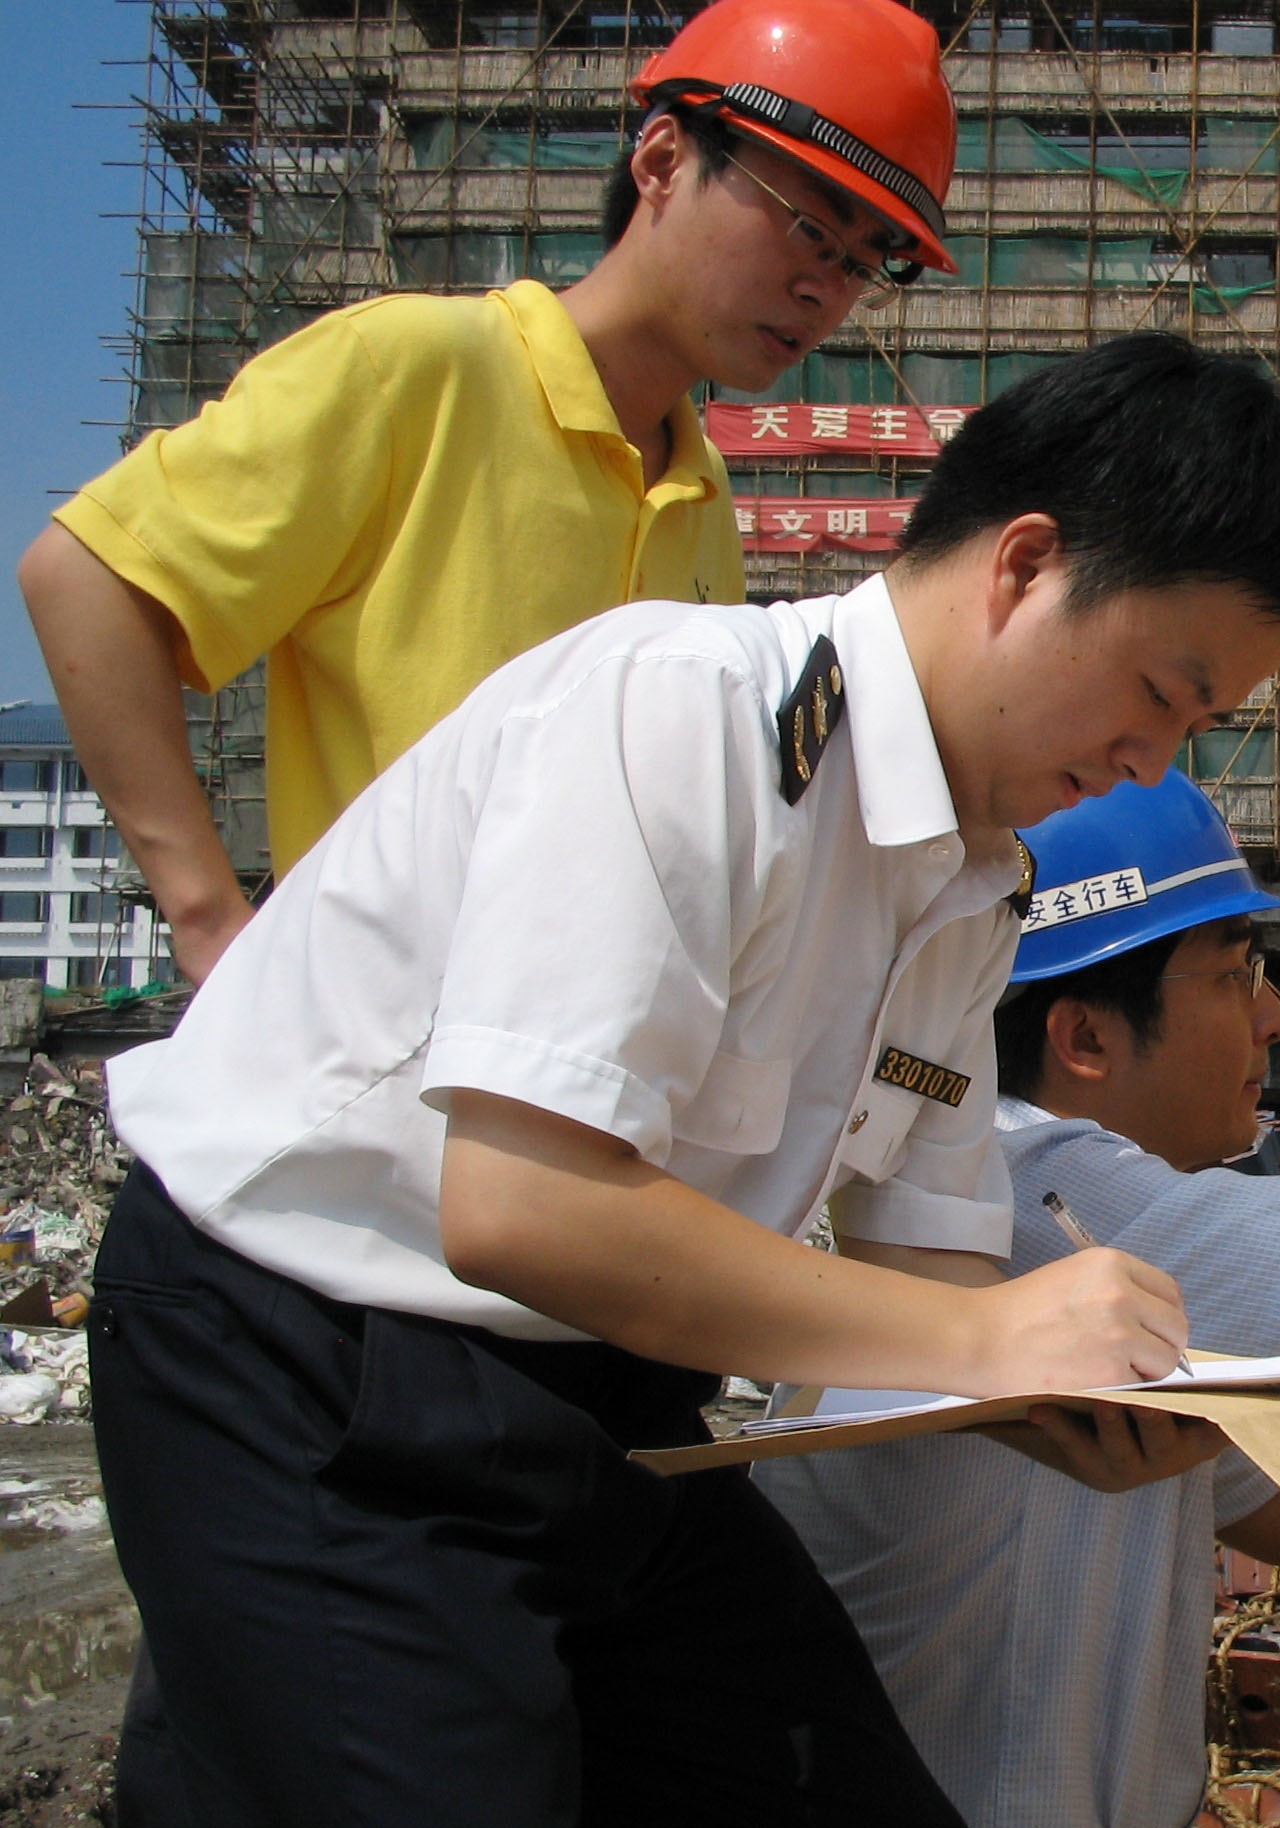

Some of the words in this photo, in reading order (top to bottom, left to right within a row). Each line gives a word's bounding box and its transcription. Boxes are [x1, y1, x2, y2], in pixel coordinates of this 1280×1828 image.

[1026, 873, 1140, 927] 安全行车
[880, 1051, 967, 1104] 3301070
